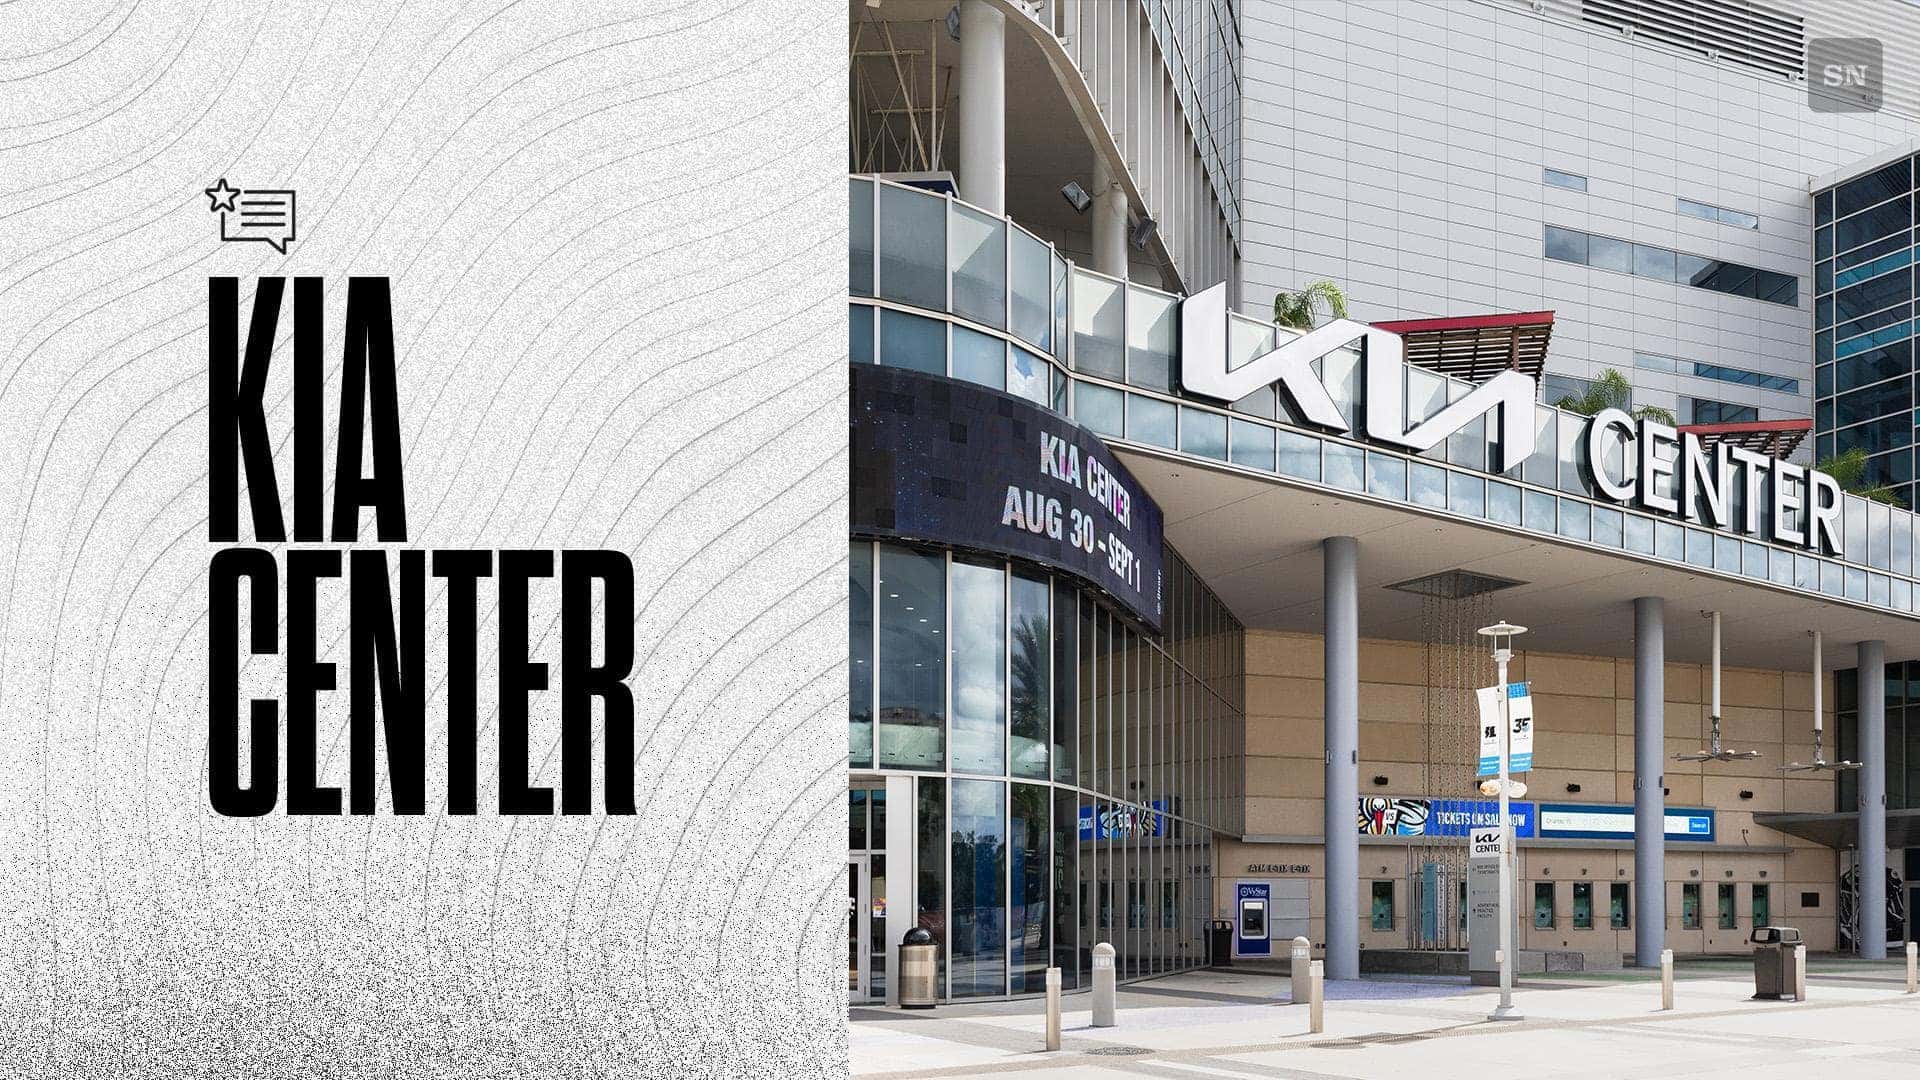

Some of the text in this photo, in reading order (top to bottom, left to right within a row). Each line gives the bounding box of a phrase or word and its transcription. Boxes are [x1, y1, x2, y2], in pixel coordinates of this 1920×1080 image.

[1181, 281, 1844, 556] KIA CENTER
[1040, 430, 1131, 532] KIA CENTER
[1001, 485, 1063, 541] AUG
[1070, 508, 1095, 554] 30
[1108, 532, 1134, 586] SEPT
[1135, 558, 1141, 592] 1
[1385, 810, 1395, 821] VS
[1437, 811, 1471, 825] TICKETS
[1485, 812, 1500, 826] SAL
